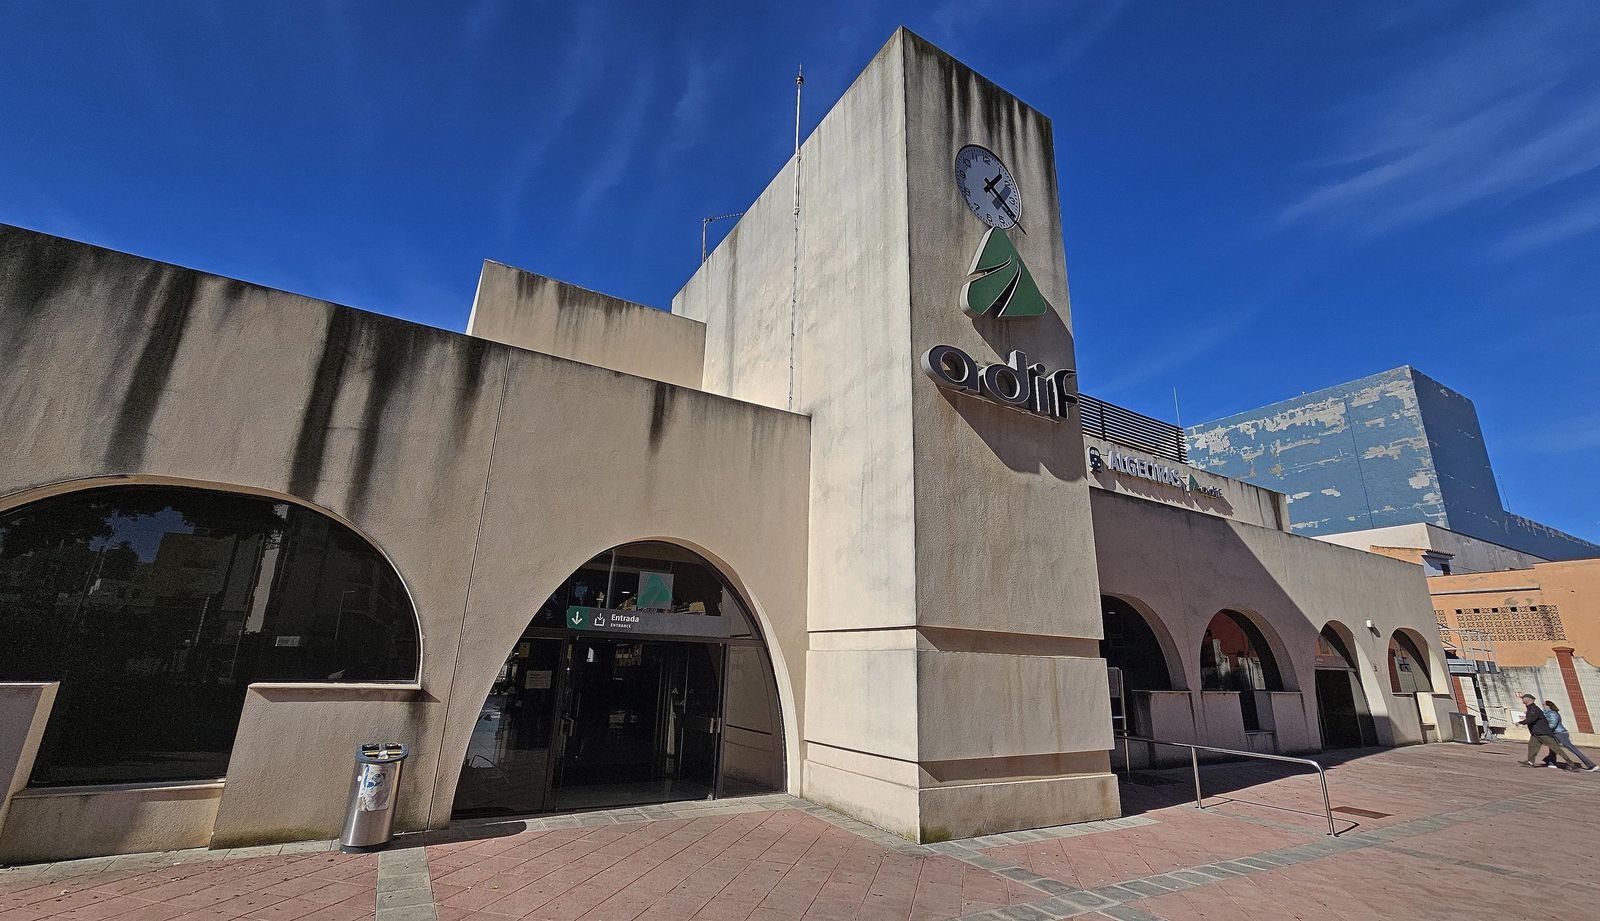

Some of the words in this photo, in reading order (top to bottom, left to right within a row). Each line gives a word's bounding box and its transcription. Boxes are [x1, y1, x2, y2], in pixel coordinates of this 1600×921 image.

[983, 154, 991, 166] 12
[1009, 196, 1016, 206] 3
[998, 214, 1006, 224] 5
[921, 344, 1079, 420] adif
[1108, 450, 1182, 488] ALGECIRAS
[611, 613, 640, 623] Entrada
